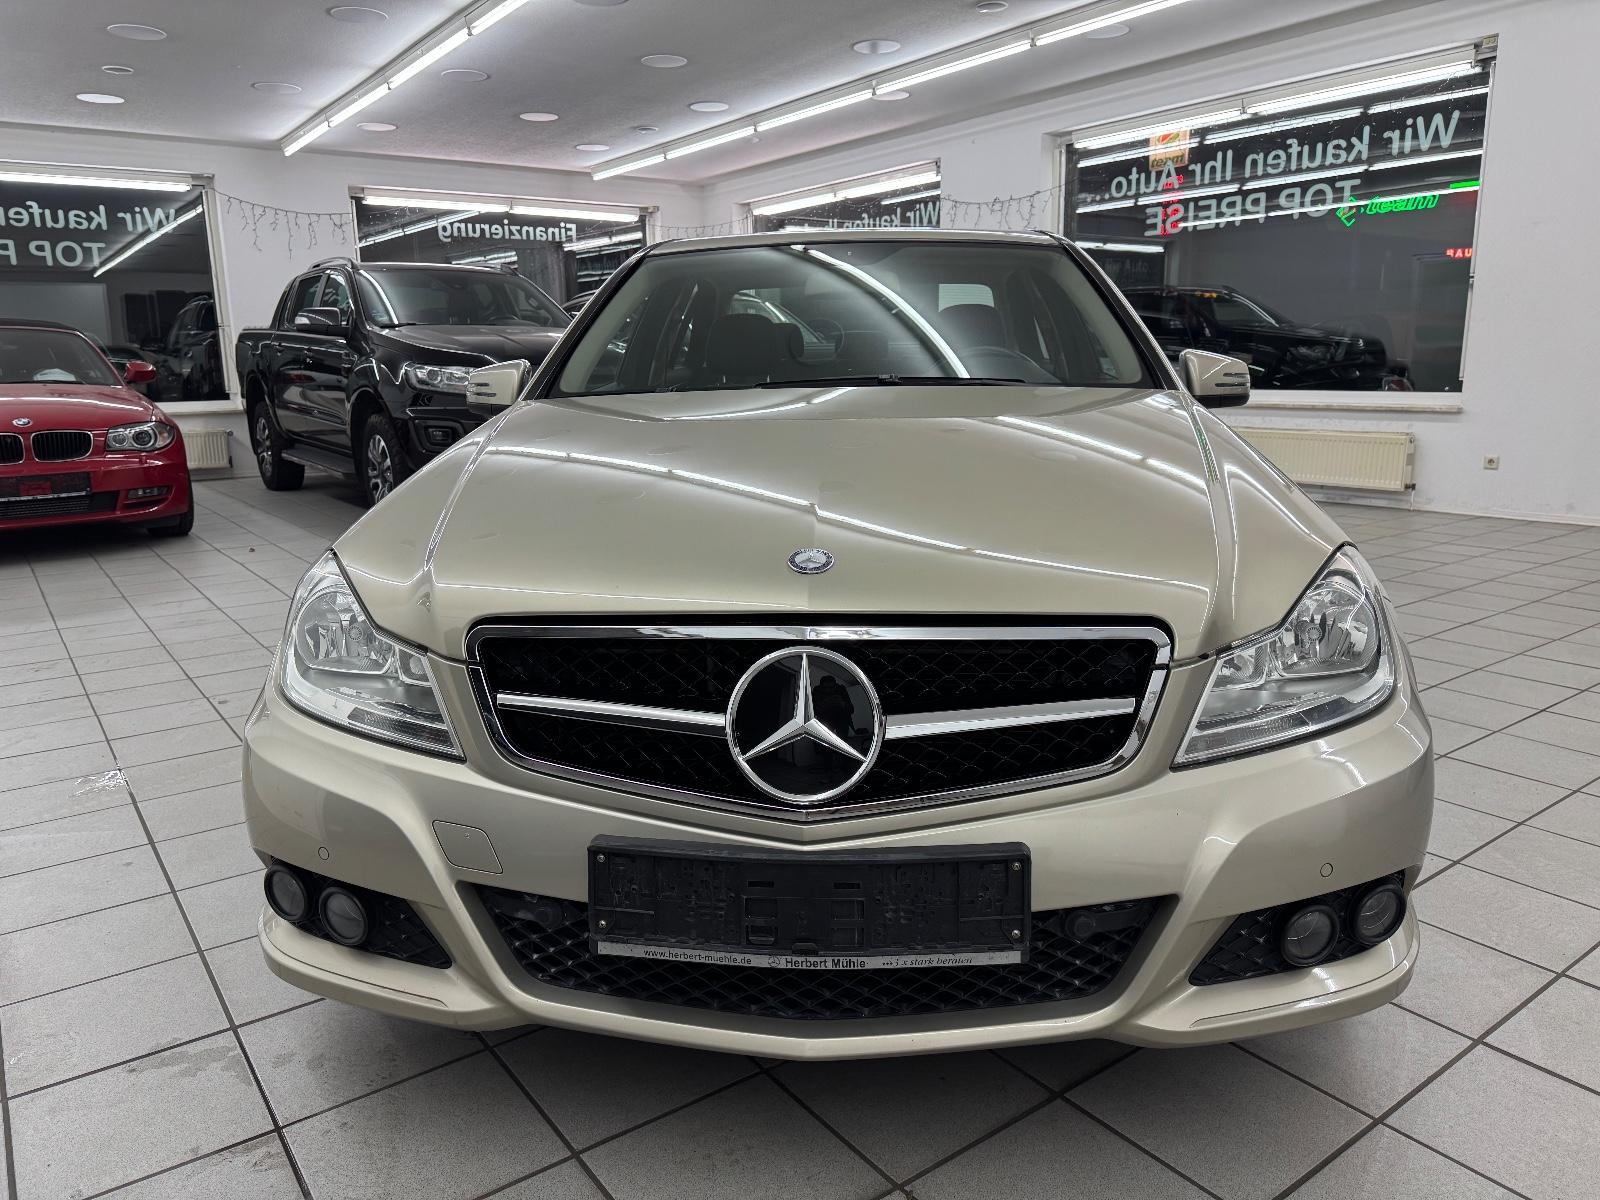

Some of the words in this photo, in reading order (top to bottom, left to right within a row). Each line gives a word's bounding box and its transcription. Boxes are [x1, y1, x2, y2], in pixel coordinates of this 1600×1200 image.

[643, 949, 752, 966] www.herbert-muehle.de
[785, 957, 828, 969] Herbert
[831, 957, 867, 969] Mühle
[909, 957, 934, 967] stark
